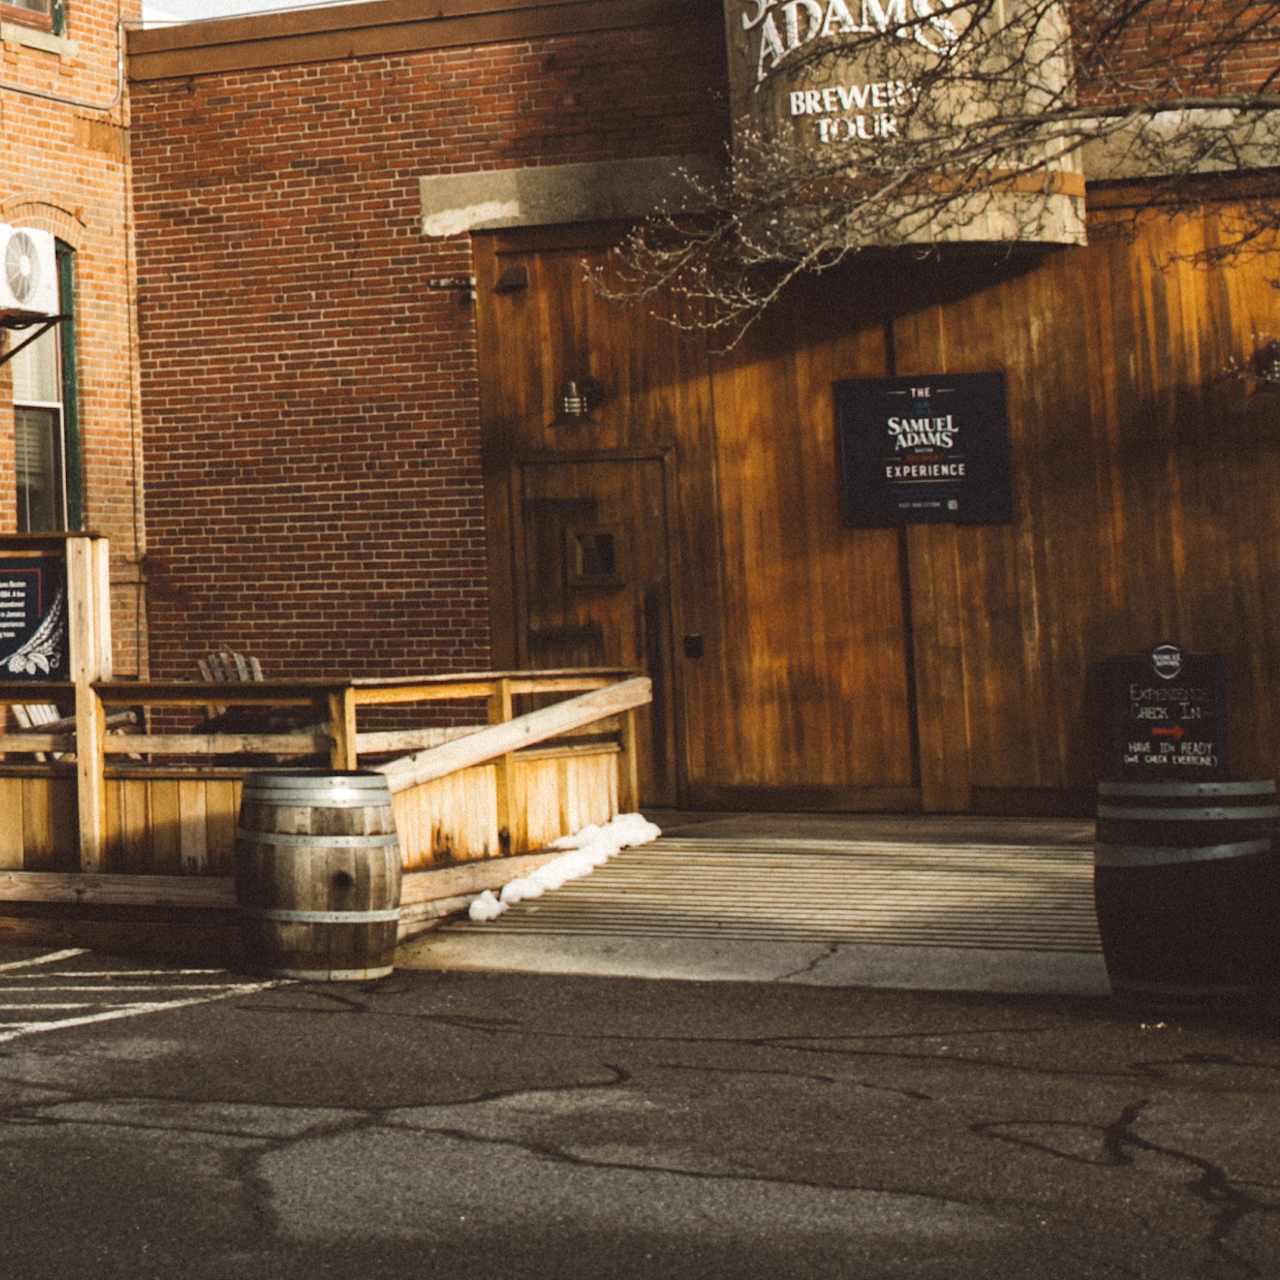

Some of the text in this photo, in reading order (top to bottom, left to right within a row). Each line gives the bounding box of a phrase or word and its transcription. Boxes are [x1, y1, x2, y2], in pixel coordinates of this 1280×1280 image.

[817, 112, 898, 144] TOUR
[910, 387, 931, 398] THE
[887, 414, 959, 435] SAMUEL
[895, 432, 953, 451] ADAMS
[885, 463, 966, 478] EXPERIENCE
